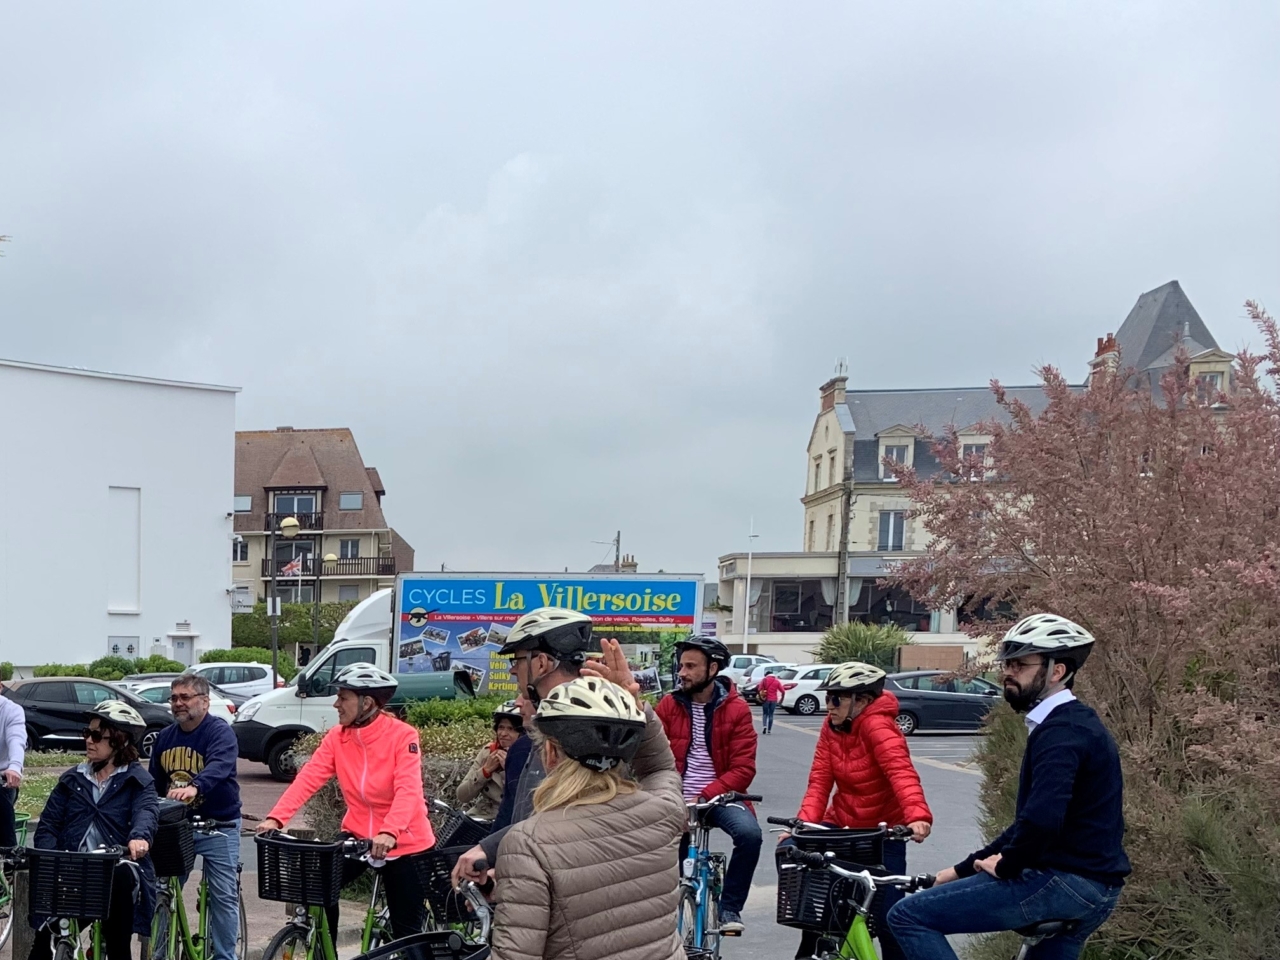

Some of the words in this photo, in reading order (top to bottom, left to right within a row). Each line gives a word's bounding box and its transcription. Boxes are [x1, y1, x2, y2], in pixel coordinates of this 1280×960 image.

[408, 588, 486, 605] CYCLES
[493, 581, 526, 611] La
[537, 583, 681, 612] Villersoise
[490, 661, 507, 670] Vélo
[489, 671, 511, 680] Sulky
[488, 682, 518, 691] Karting
[160, 746, 205, 775] MICHIGAN
